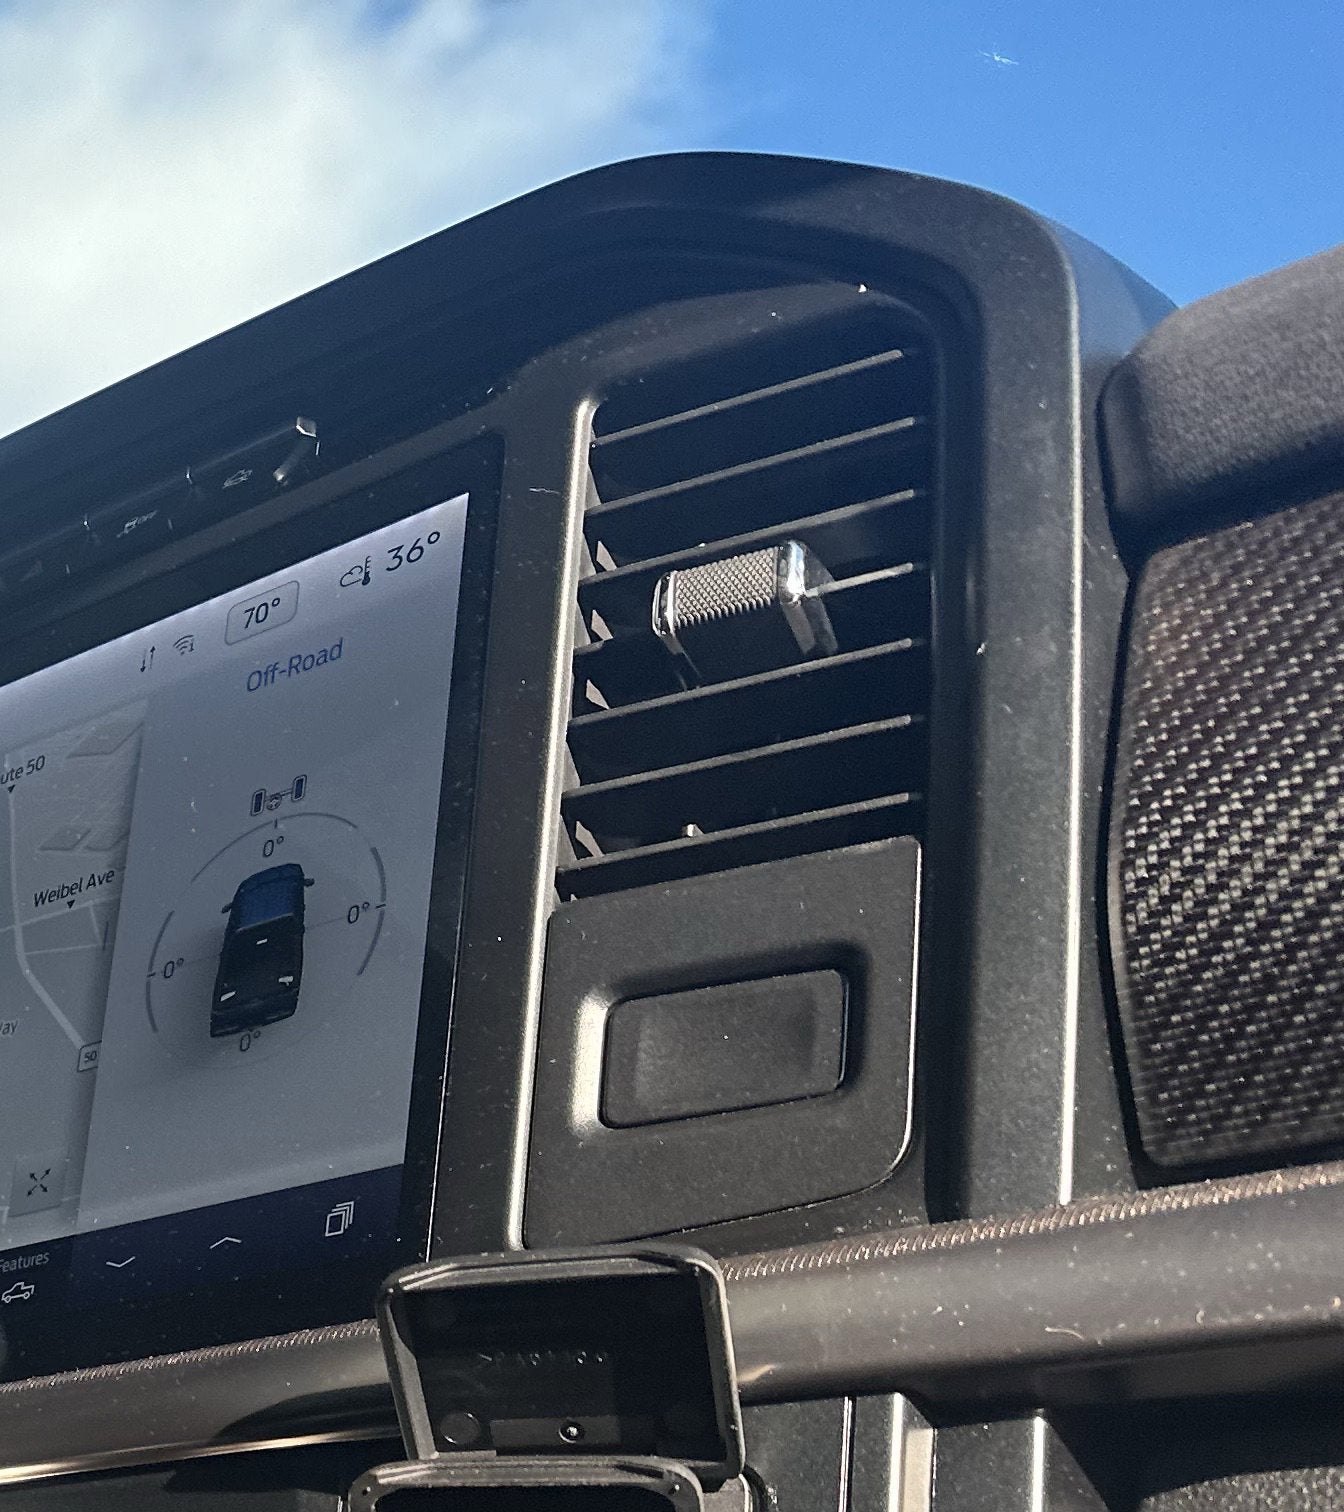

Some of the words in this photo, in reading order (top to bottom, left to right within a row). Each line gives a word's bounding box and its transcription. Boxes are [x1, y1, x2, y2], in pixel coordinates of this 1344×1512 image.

[243, 597, 281, 629] 70°
[246, 637, 344, 692] Off-Road
[26, 755, 46, 773] 50
[33, 878, 83, 908] Weibel
[86, 870, 115, 890] Ave
[84, 1050, 97, 1064] 50
